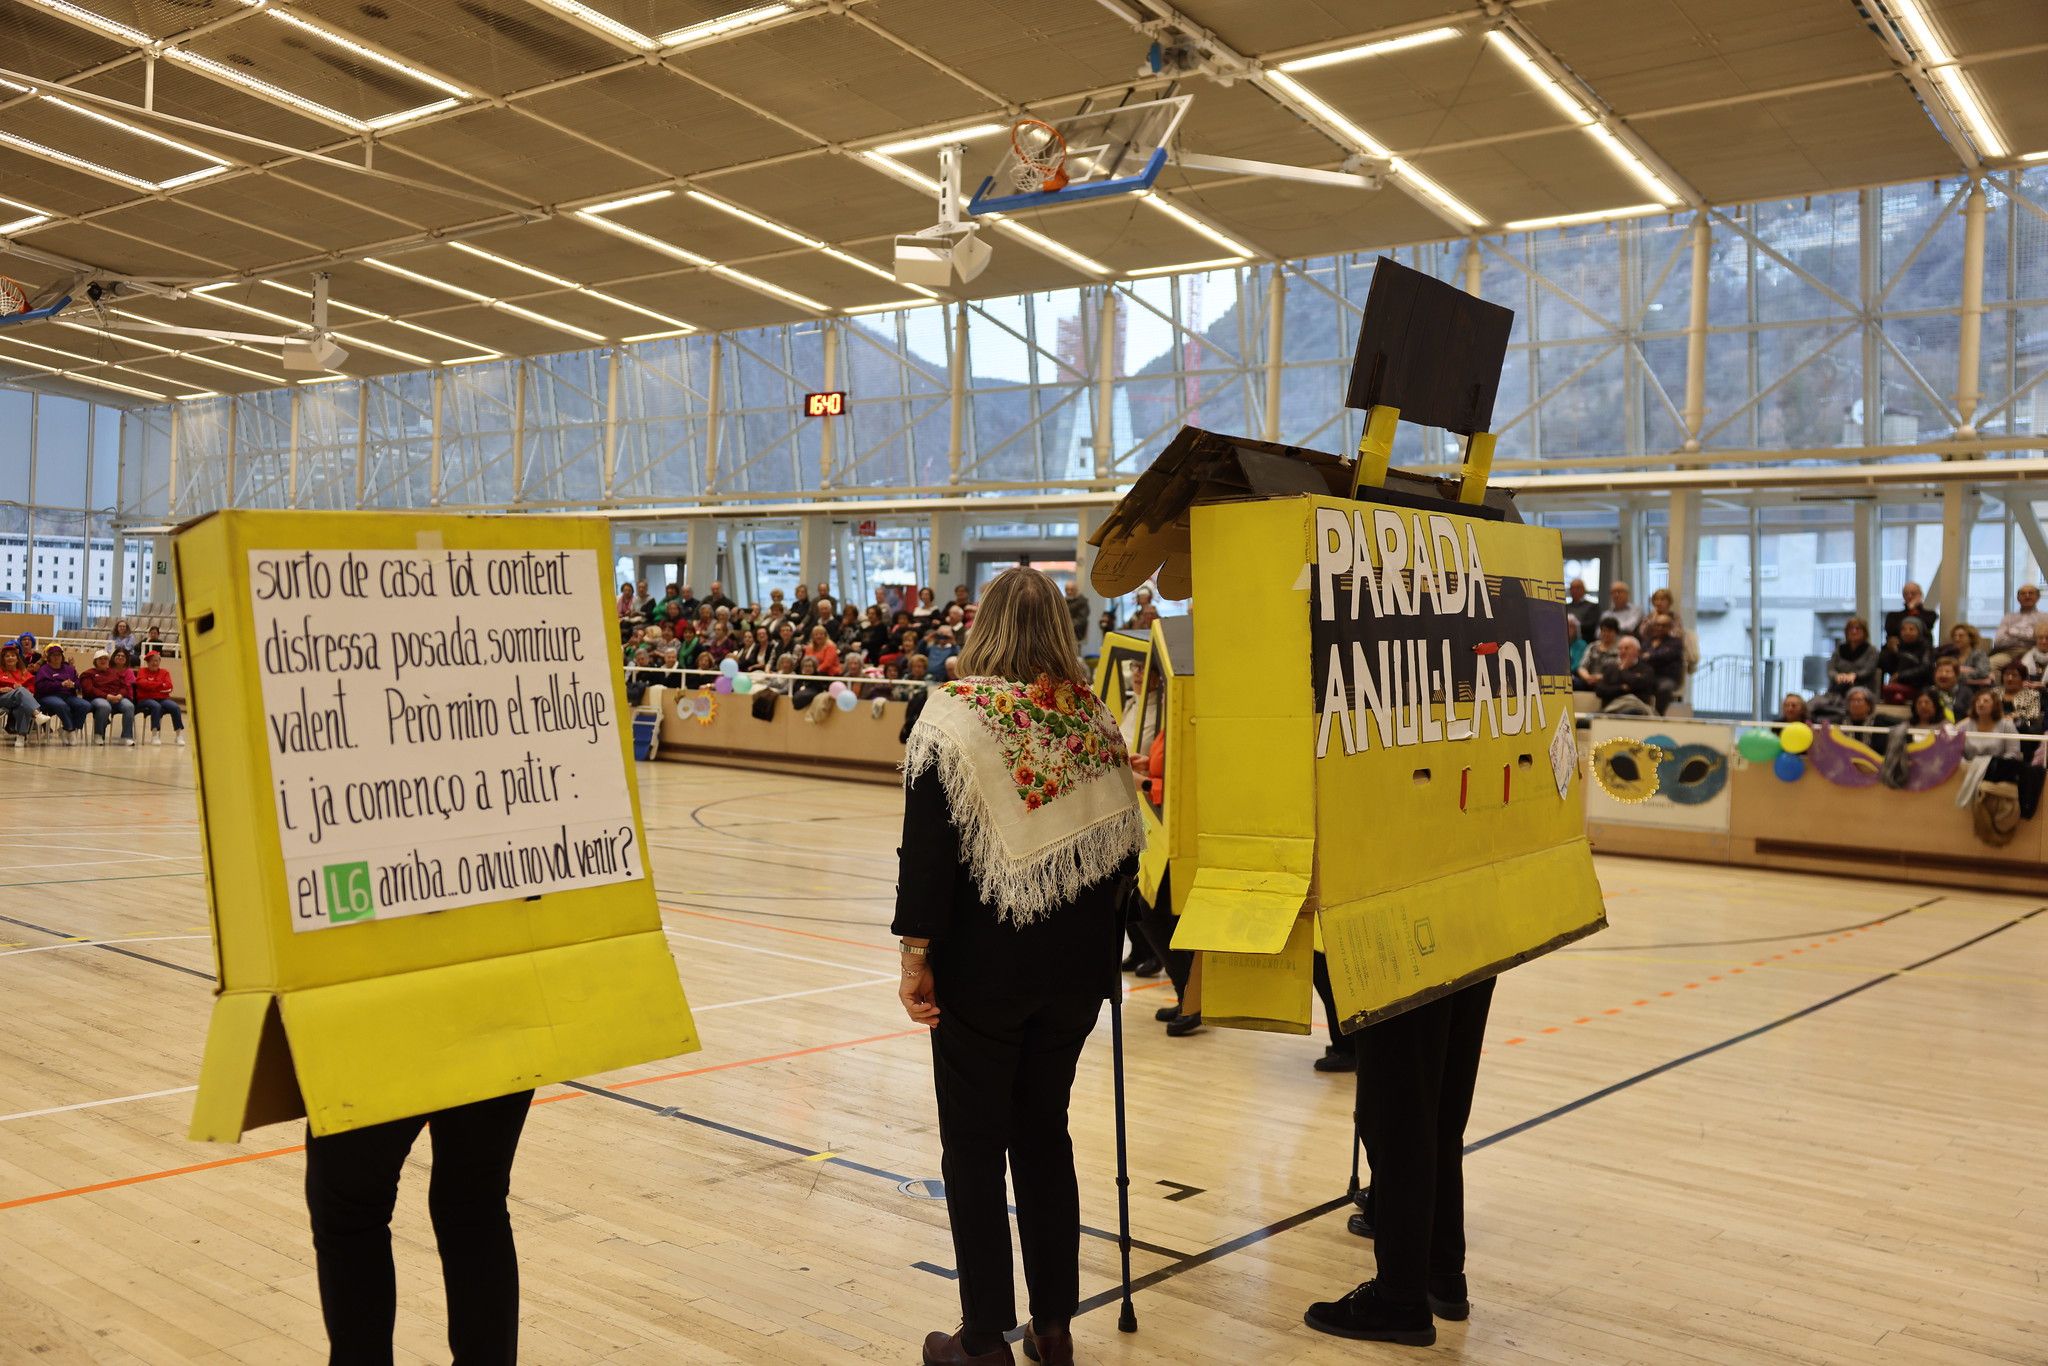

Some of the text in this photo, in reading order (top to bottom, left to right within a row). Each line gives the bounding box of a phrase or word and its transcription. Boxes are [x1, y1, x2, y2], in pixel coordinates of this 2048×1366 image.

[256, 550, 573, 600] surto de casa tot content
[1316, 507, 1493, 621] PARADA
[265, 614, 381, 675] disfressa
[270, 671, 609, 754] valent. Però miro el rellotge
[280, 780, 298, 830] i
[309, 776, 340, 844] ja
[345, 774, 465, 821] començo
[475, 770, 493, 810] a
[298, 869, 327, 919] el
[329, 868, 370, 915] L6
[476, 840, 520, 892] avui
[518, 846, 544, 884] no
[542, 824, 575, 882] vol
[574, 826, 633, 877] venir?
